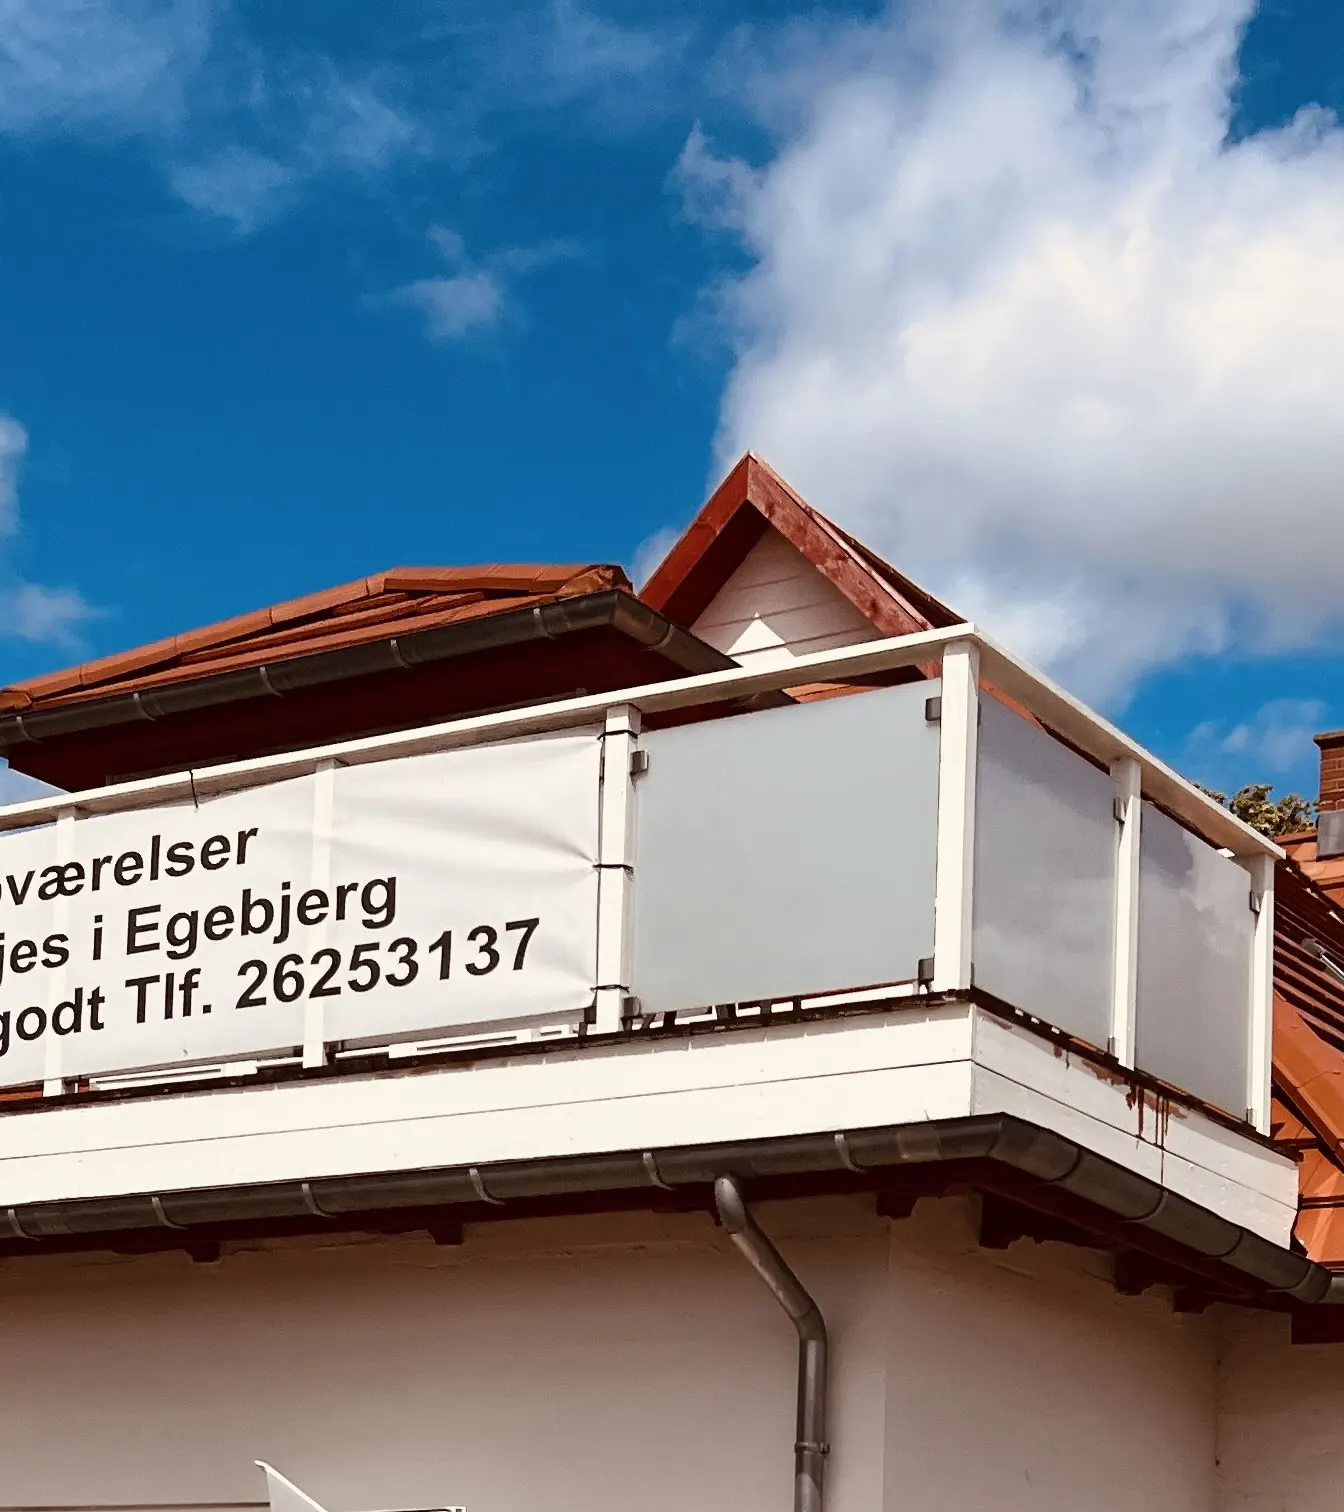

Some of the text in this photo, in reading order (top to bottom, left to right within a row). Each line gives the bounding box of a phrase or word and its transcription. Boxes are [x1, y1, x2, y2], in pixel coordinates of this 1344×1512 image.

[92, 914, 103, 961] i
[126, 876, 398, 957] Egebjerg
[125, 968, 212, 1024] Tlf.
[235, 917, 541, 1010] 26253137
